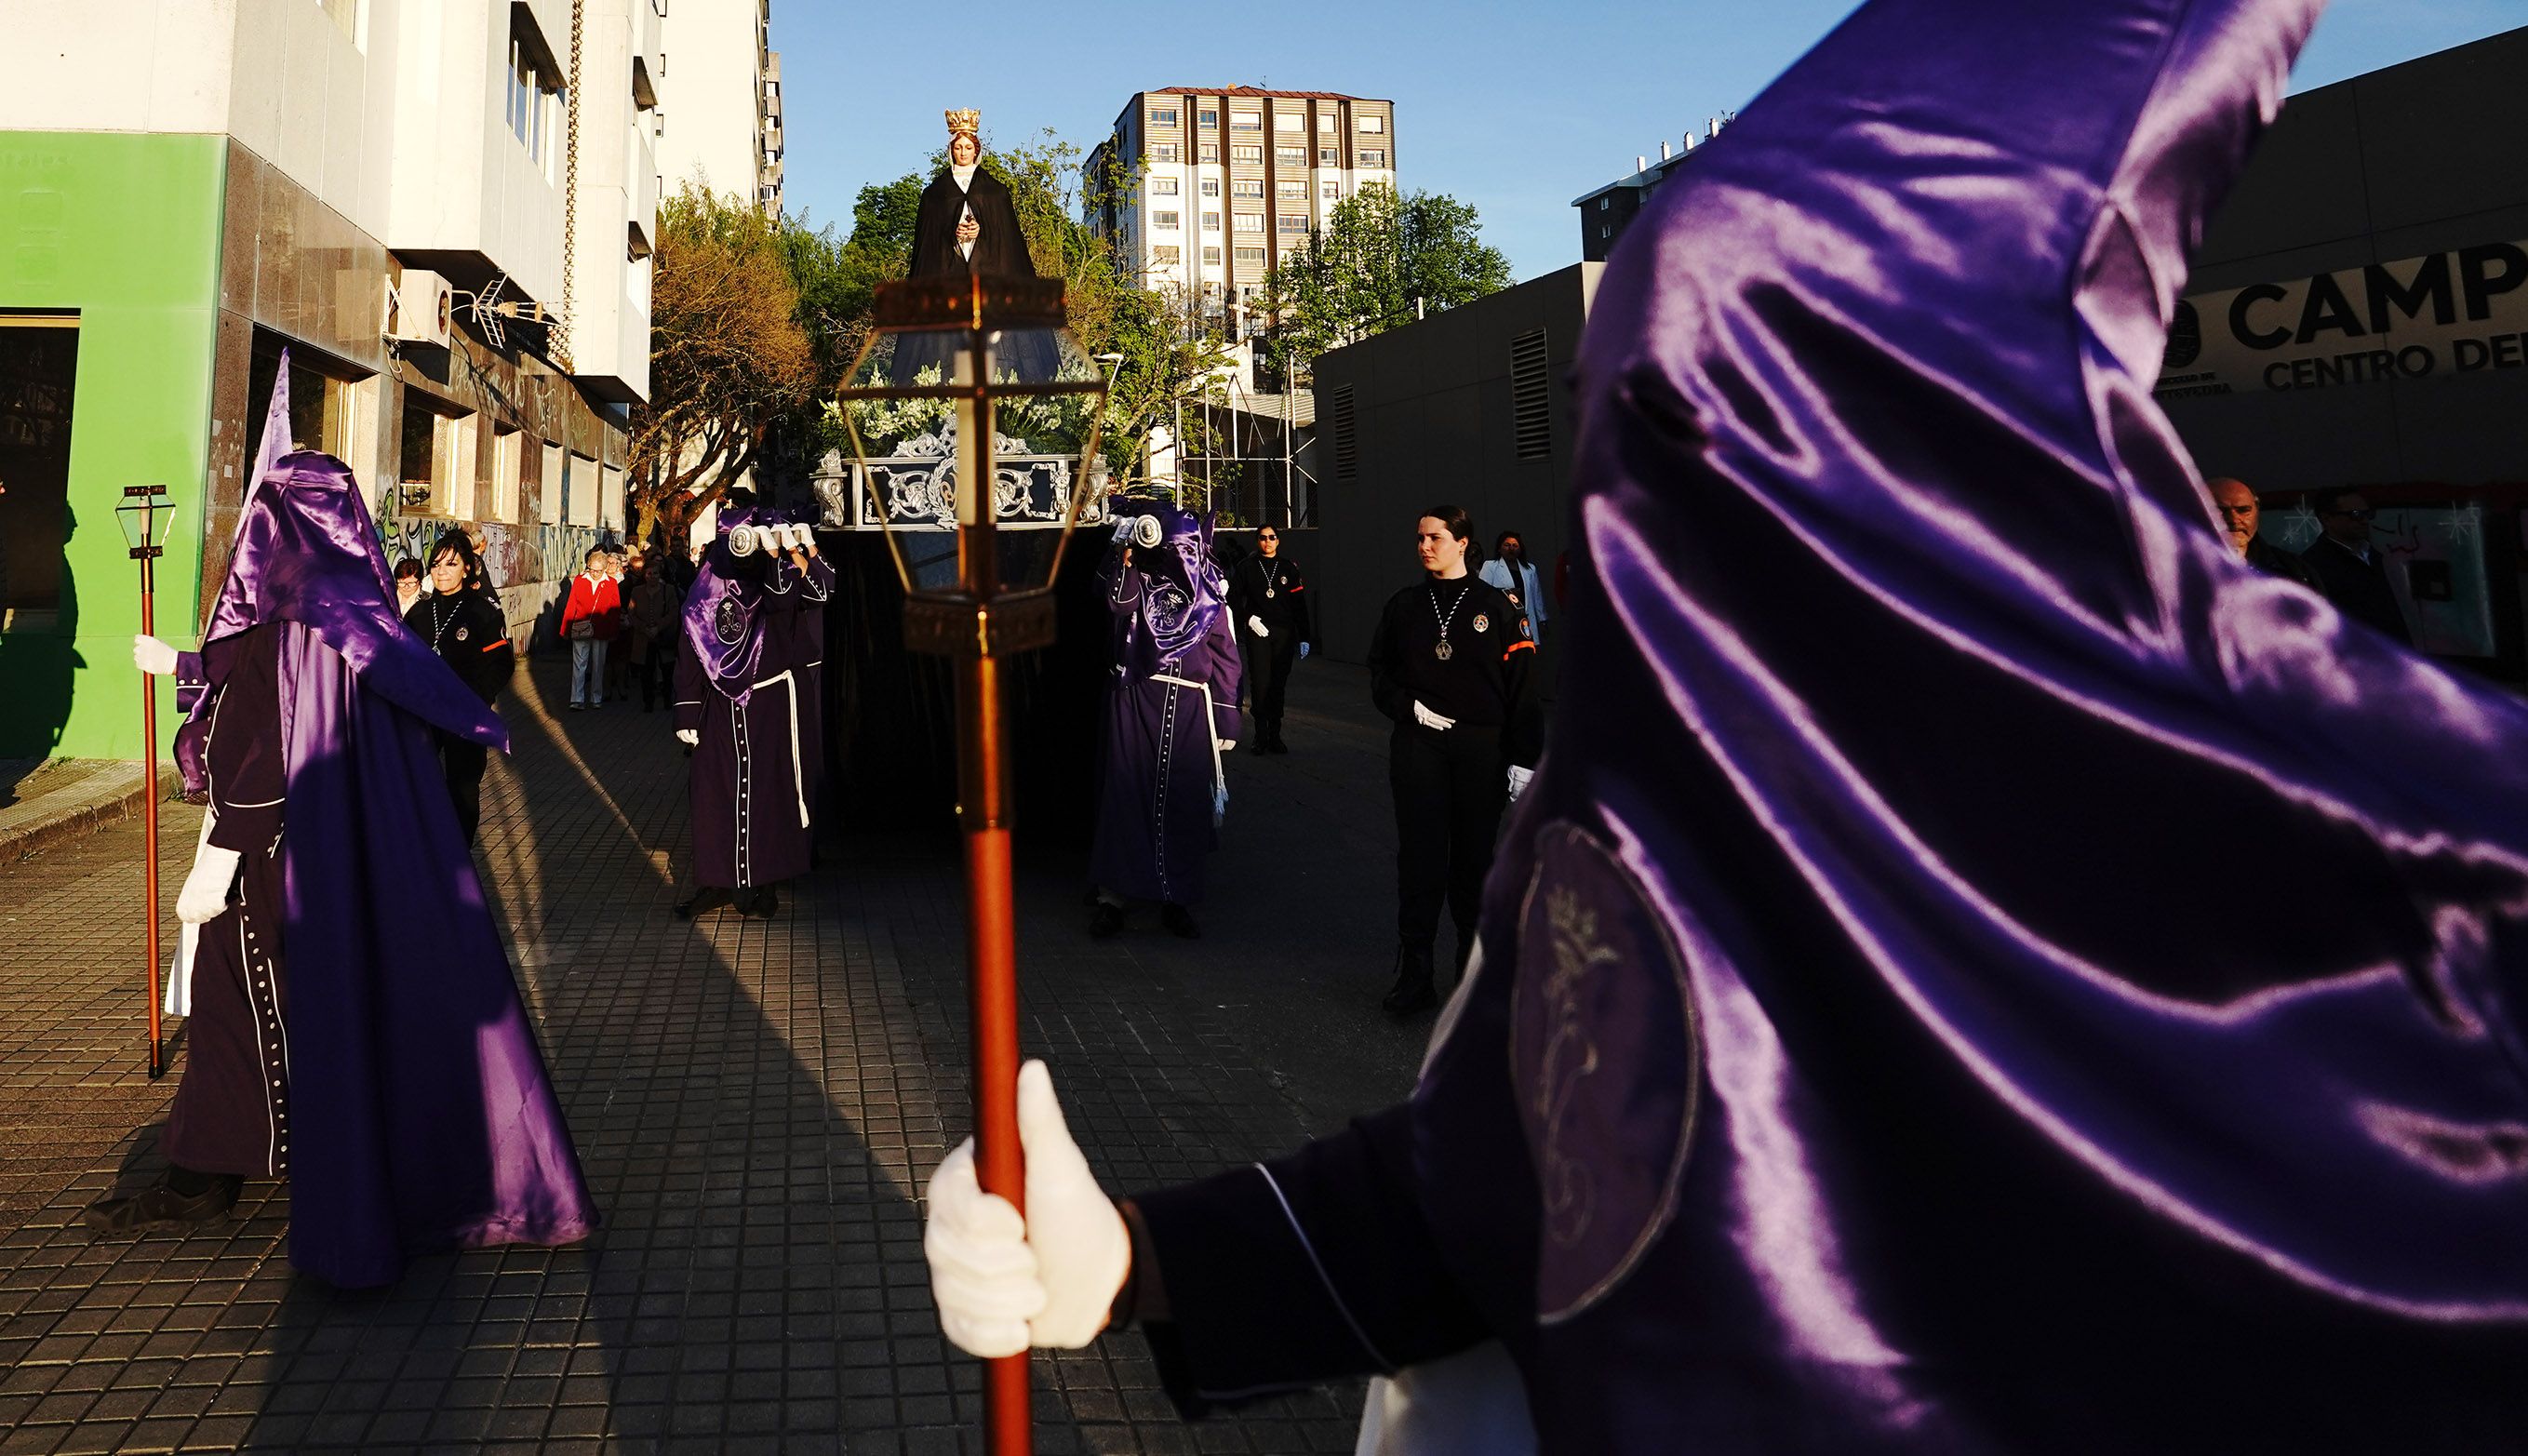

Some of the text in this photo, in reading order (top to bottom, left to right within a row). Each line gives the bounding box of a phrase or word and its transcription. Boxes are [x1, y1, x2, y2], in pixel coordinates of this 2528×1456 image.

[2228, 244, 2528, 350] CAMP
[2265, 332, 2528, 393] CENTRO DE
